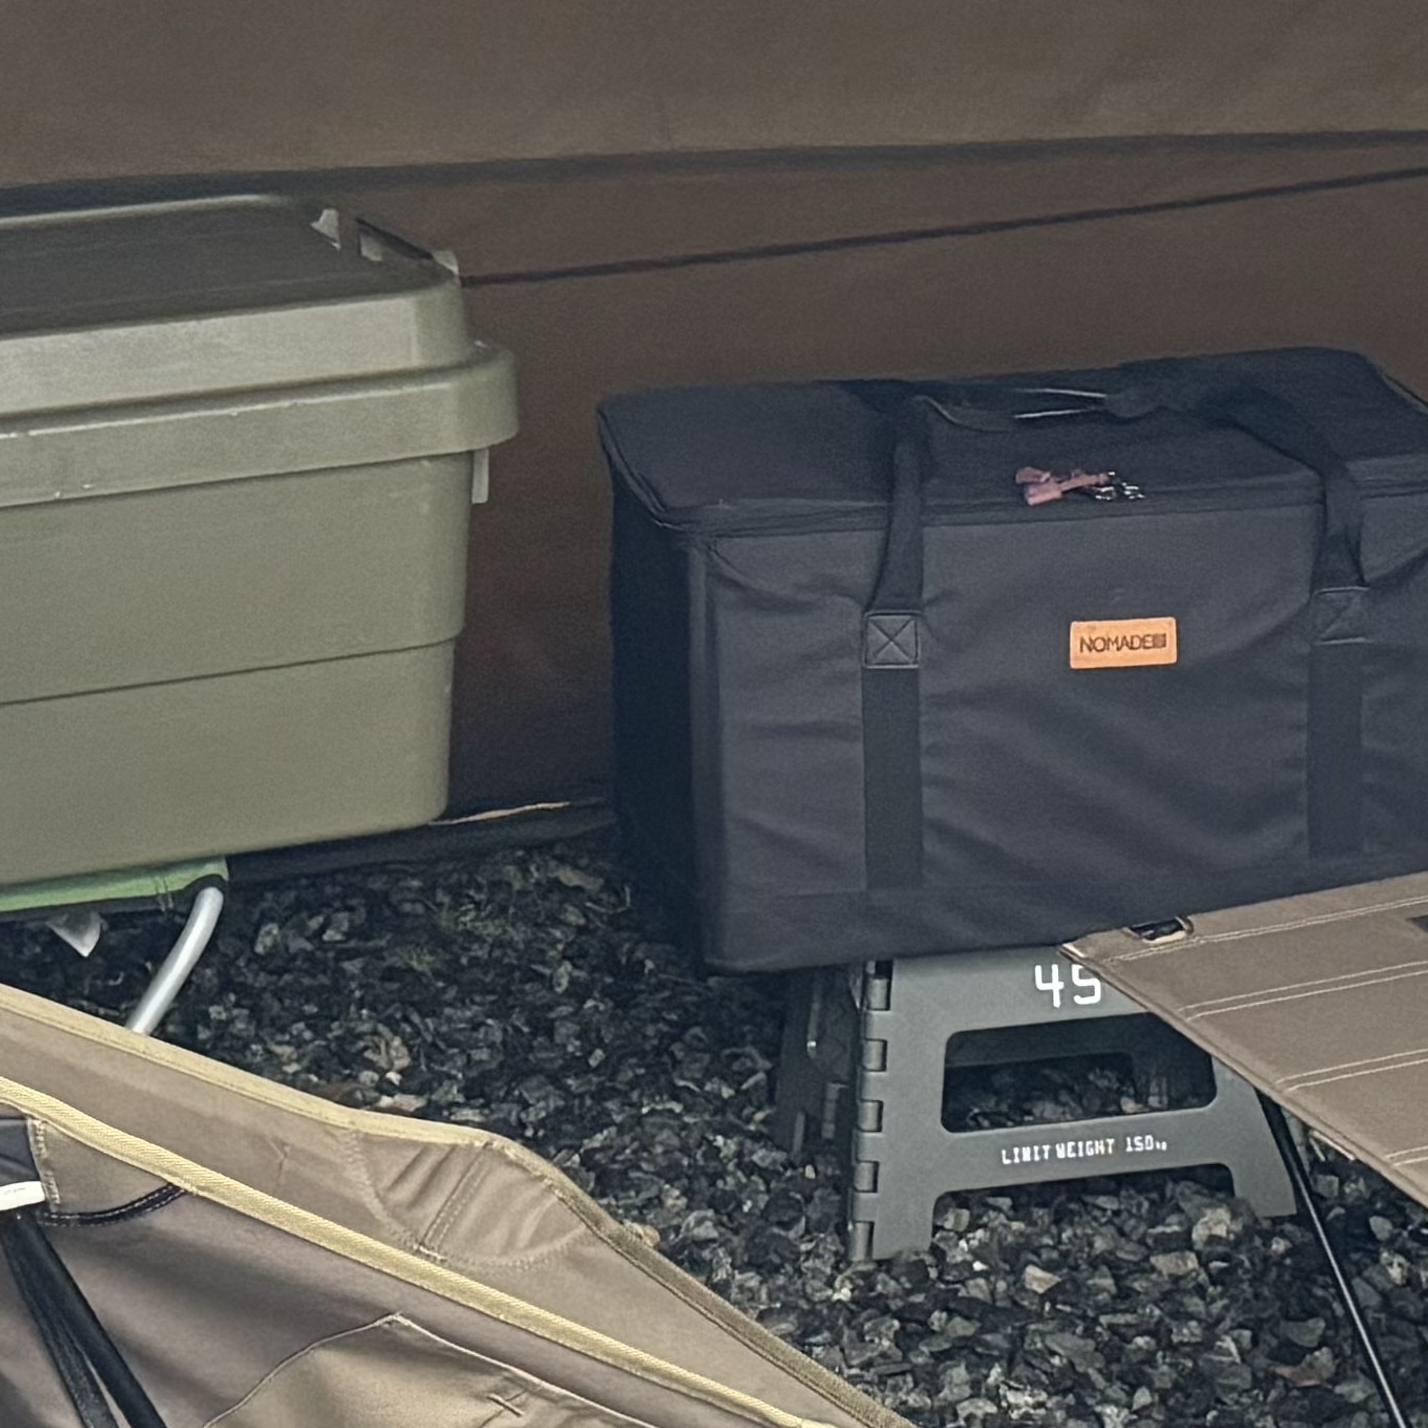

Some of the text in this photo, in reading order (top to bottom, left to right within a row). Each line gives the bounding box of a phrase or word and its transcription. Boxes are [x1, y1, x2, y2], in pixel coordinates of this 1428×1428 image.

[1034, 963, 1102, 1008] 45
[1001, 1144, 1051, 1165] LIMIT
[1055, 1138, 1116, 1160] WEIGHT
